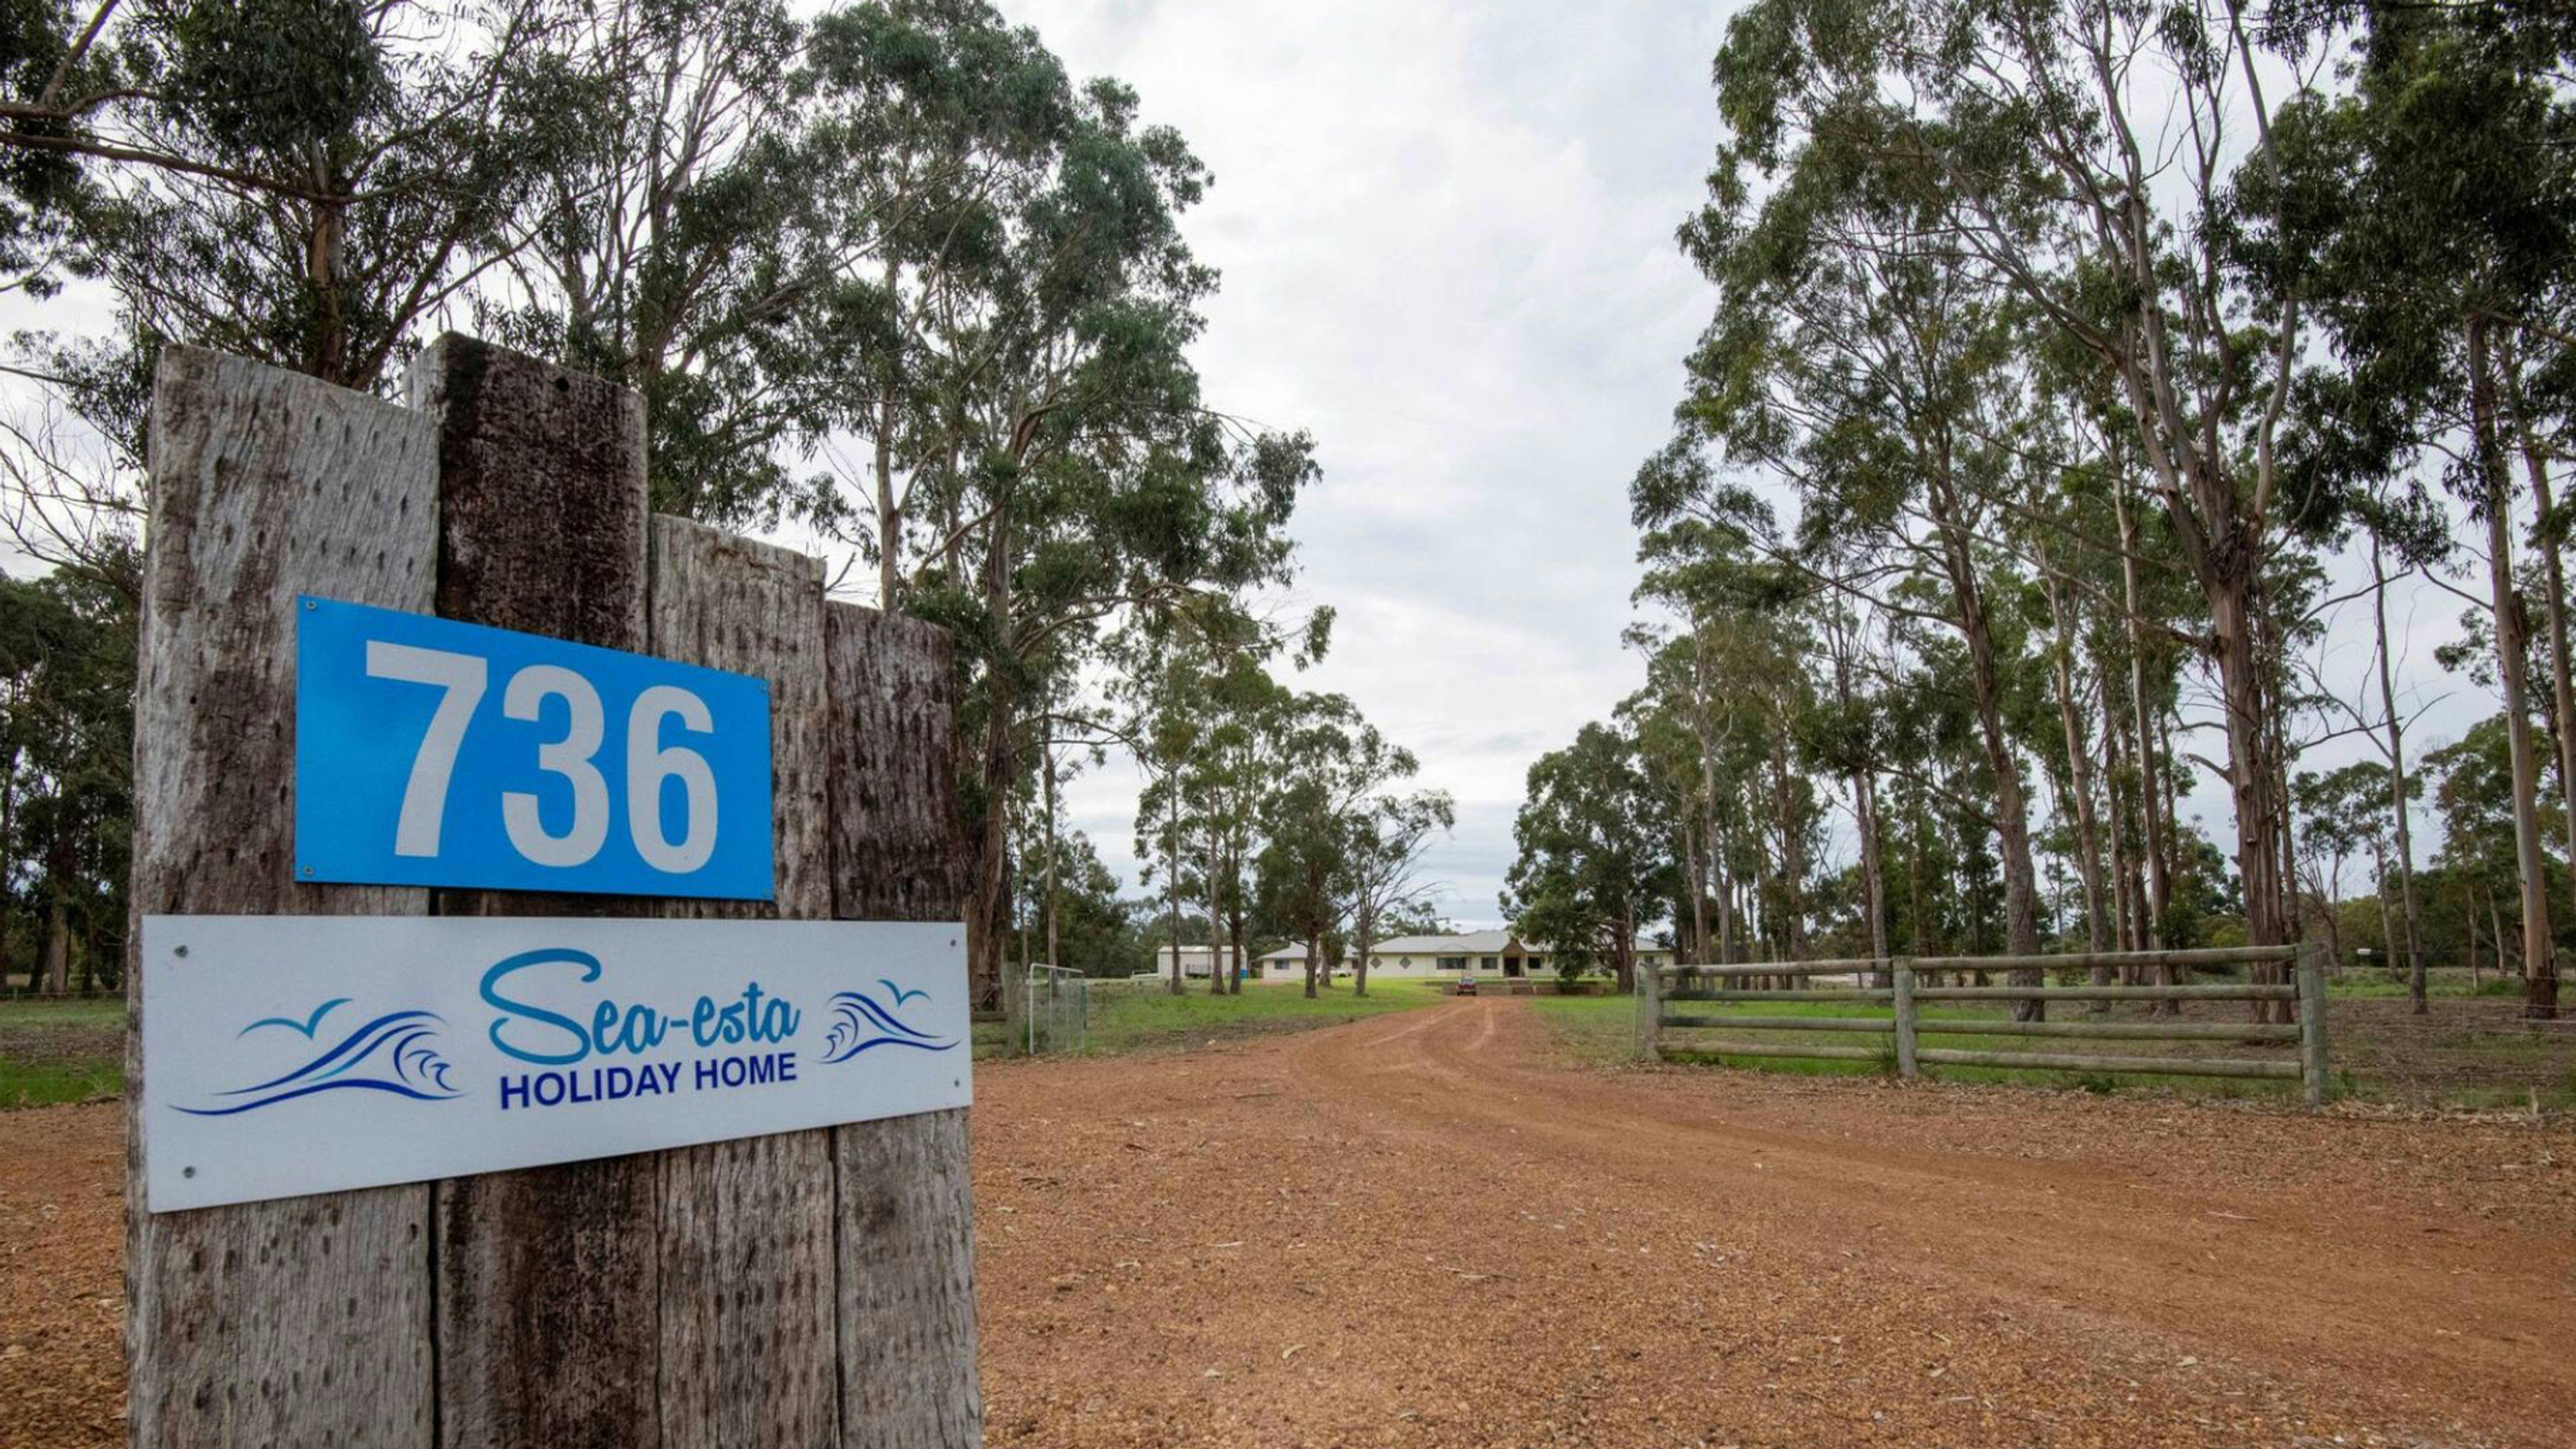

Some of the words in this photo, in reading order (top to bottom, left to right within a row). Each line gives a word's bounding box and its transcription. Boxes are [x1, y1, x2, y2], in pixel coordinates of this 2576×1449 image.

[366, 641, 718, 873] 736
[480, 949, 800, 1065] Sea-esta
[501, 1063, 681, 1109] HOLIDAY
[696, 1053, 797, 1089] HOME
